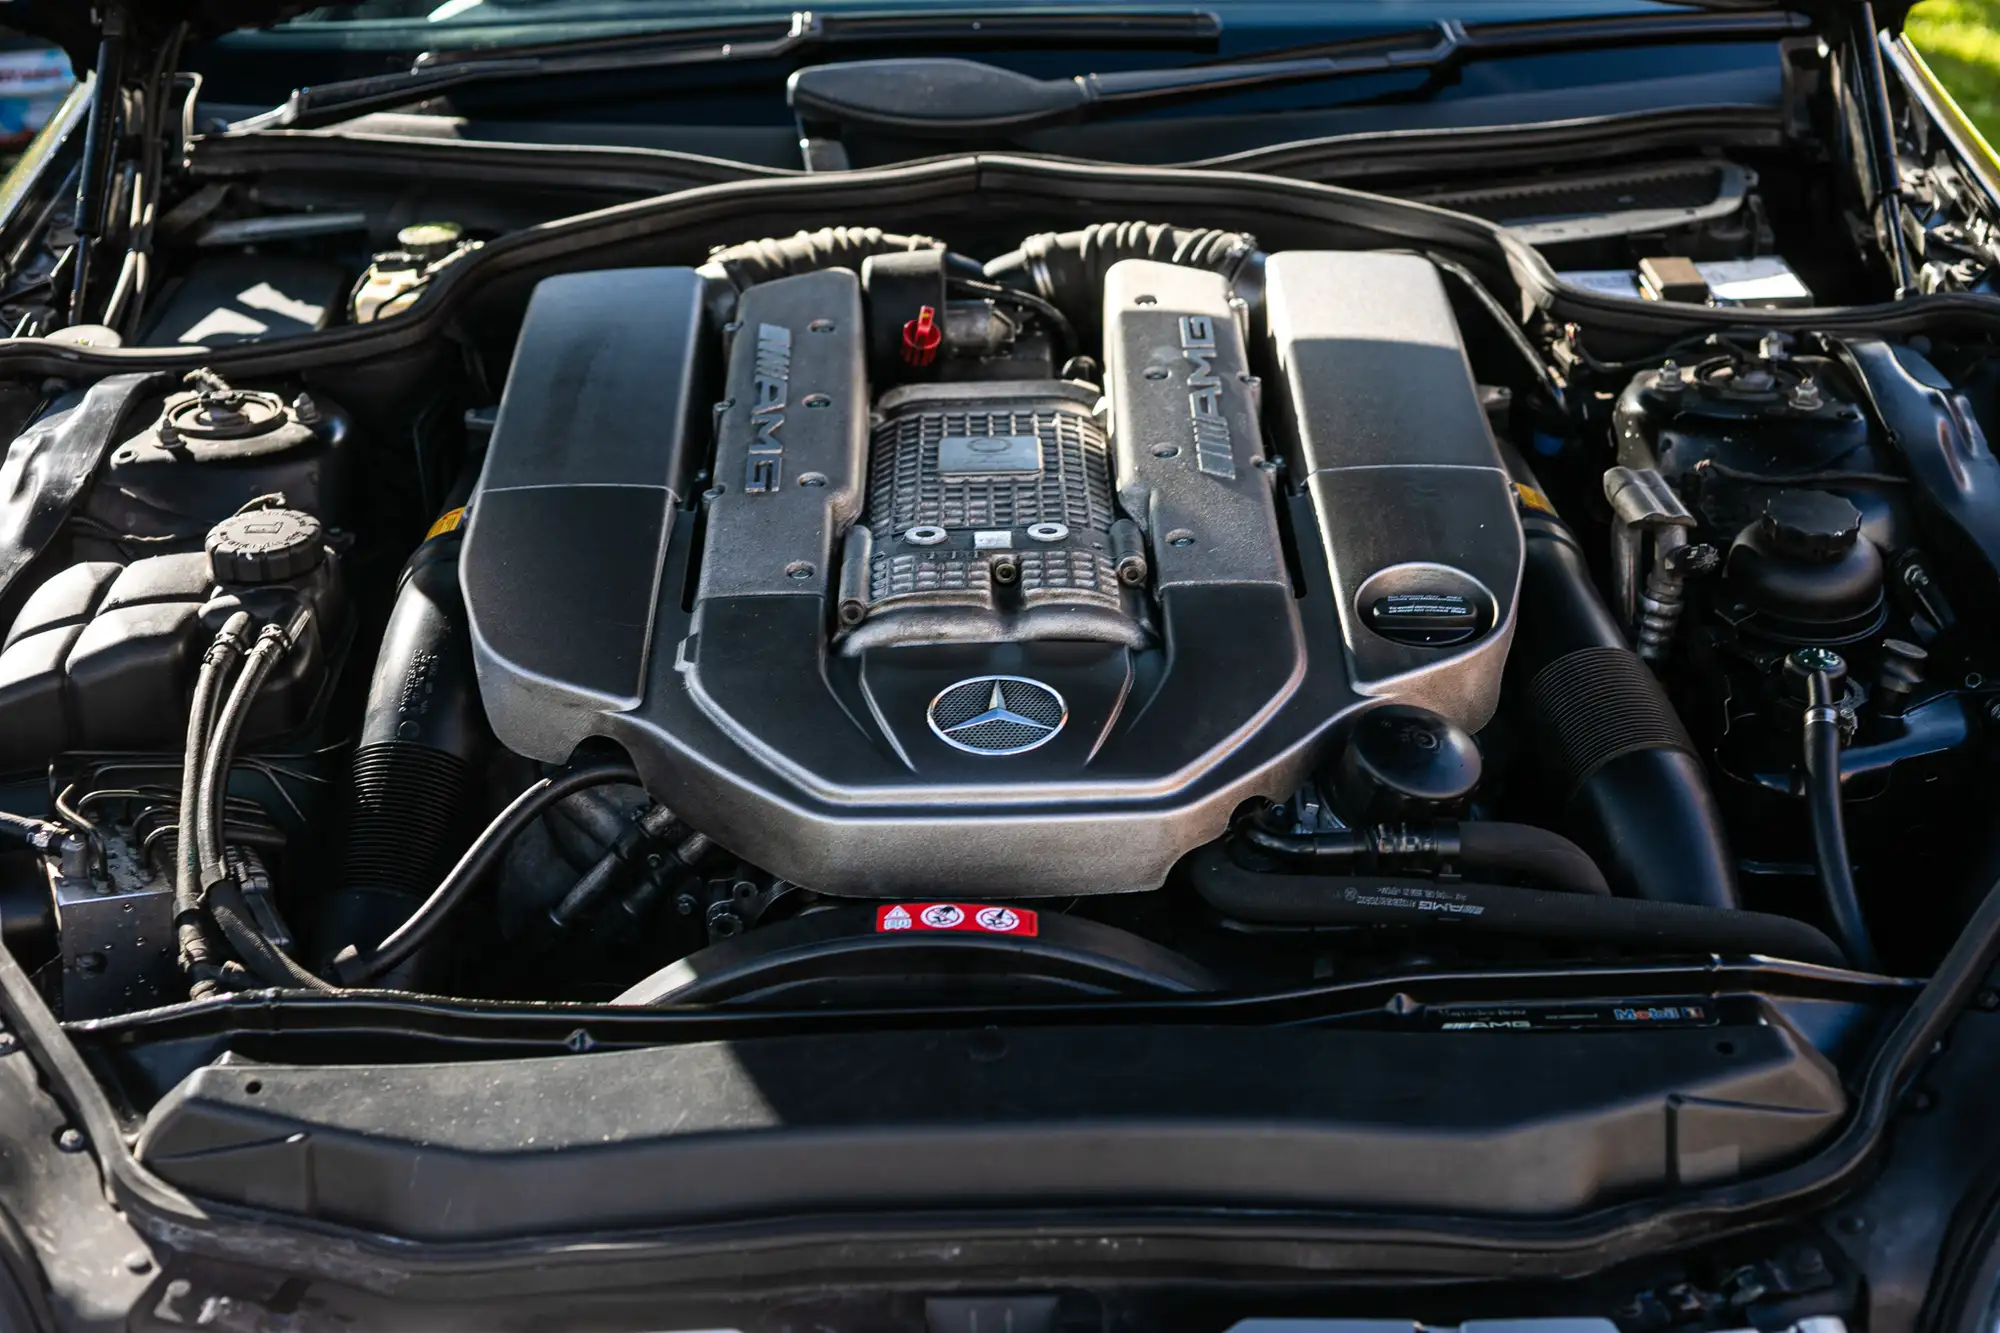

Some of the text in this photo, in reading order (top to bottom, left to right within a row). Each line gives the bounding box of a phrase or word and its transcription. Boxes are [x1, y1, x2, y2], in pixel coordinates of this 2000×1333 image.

[1178, 316, 1229, 426] AMG
[745, 370, 788, 493] AMG
[1418, 900, 1464, 913] AMG
[1613, 1007, 1680, 1020] Mobil
[1469, 1020, 1531, 1029] AMG
